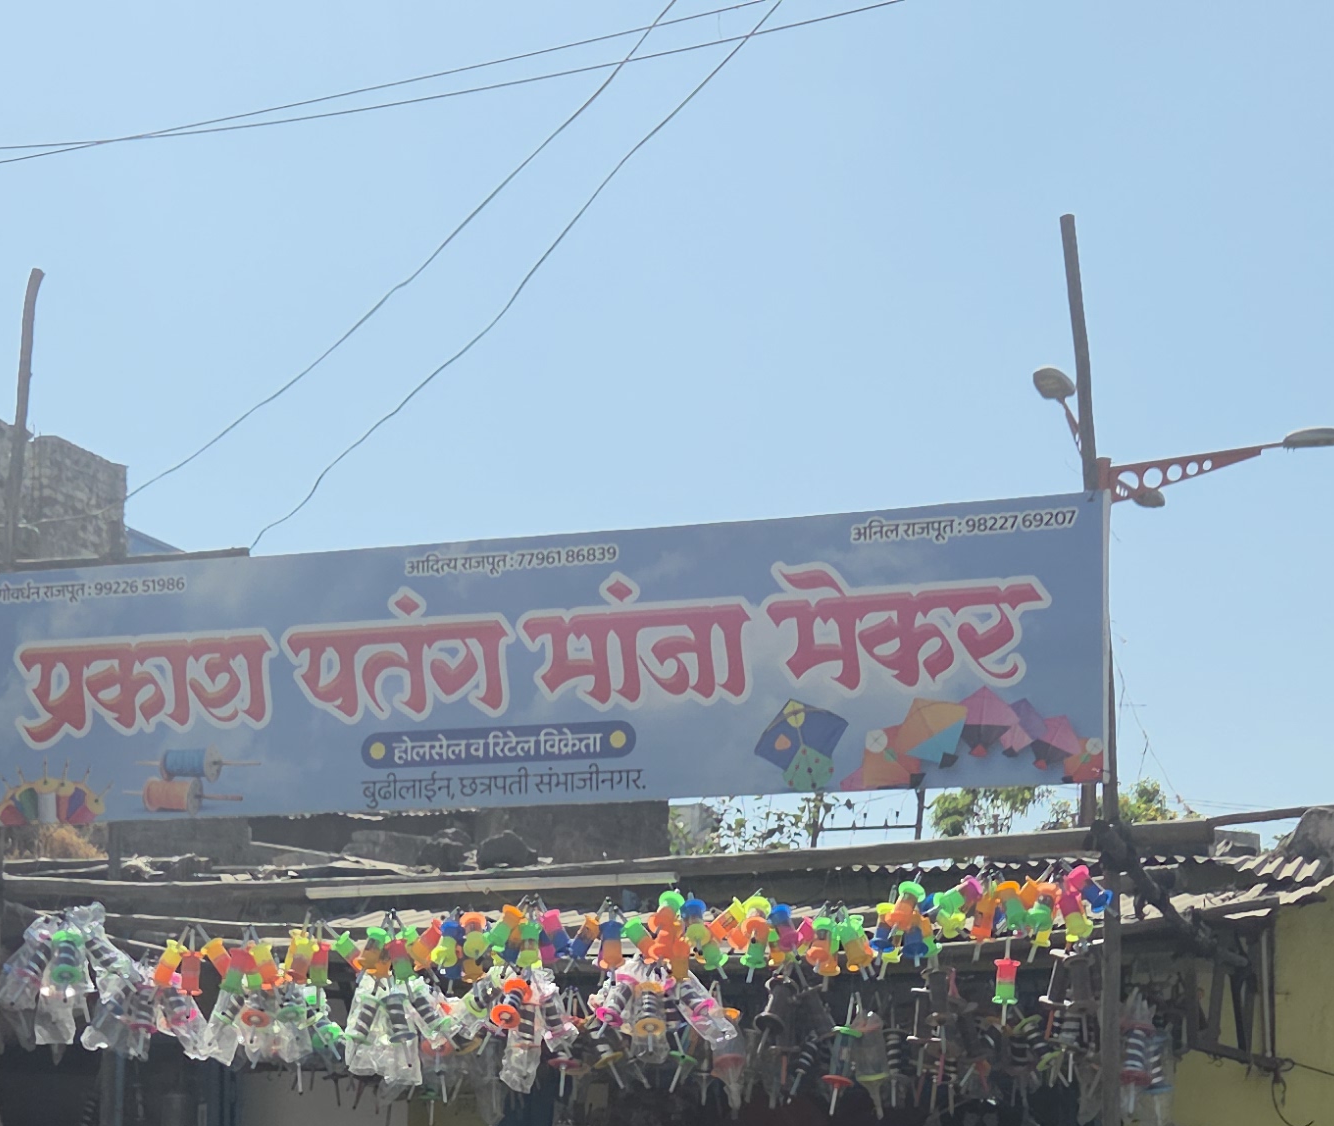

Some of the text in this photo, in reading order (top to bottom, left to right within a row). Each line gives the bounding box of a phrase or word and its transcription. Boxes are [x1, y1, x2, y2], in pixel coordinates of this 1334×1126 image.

[852, 520, 899, 542] अनिल
[903, 517, 955, 542] राजपूत
[965, 514, 1018, 533] 98227
[1021, 509, 1076, 529] 69207
[407, 554, 458, 575] आदित्य
[461, 552, 508, 575] राजपूत
[516, 549, 561, 567] 77961
[565, 545, 617, 563] 86839
[43, 582, 86, 603] राजपूत
[95, 580, 138, 595] 99226
[141, 577, 185, 592] 51986
[17, 567, 1046, 748] प्रकाश पतंग मांजा मेकर
[393, 728, 603, 764] होलसेल व रिटेल विक्रेता
[362, 763, 646, 808] बुढीलाईन, छत्रपती संभाजीनगर.
